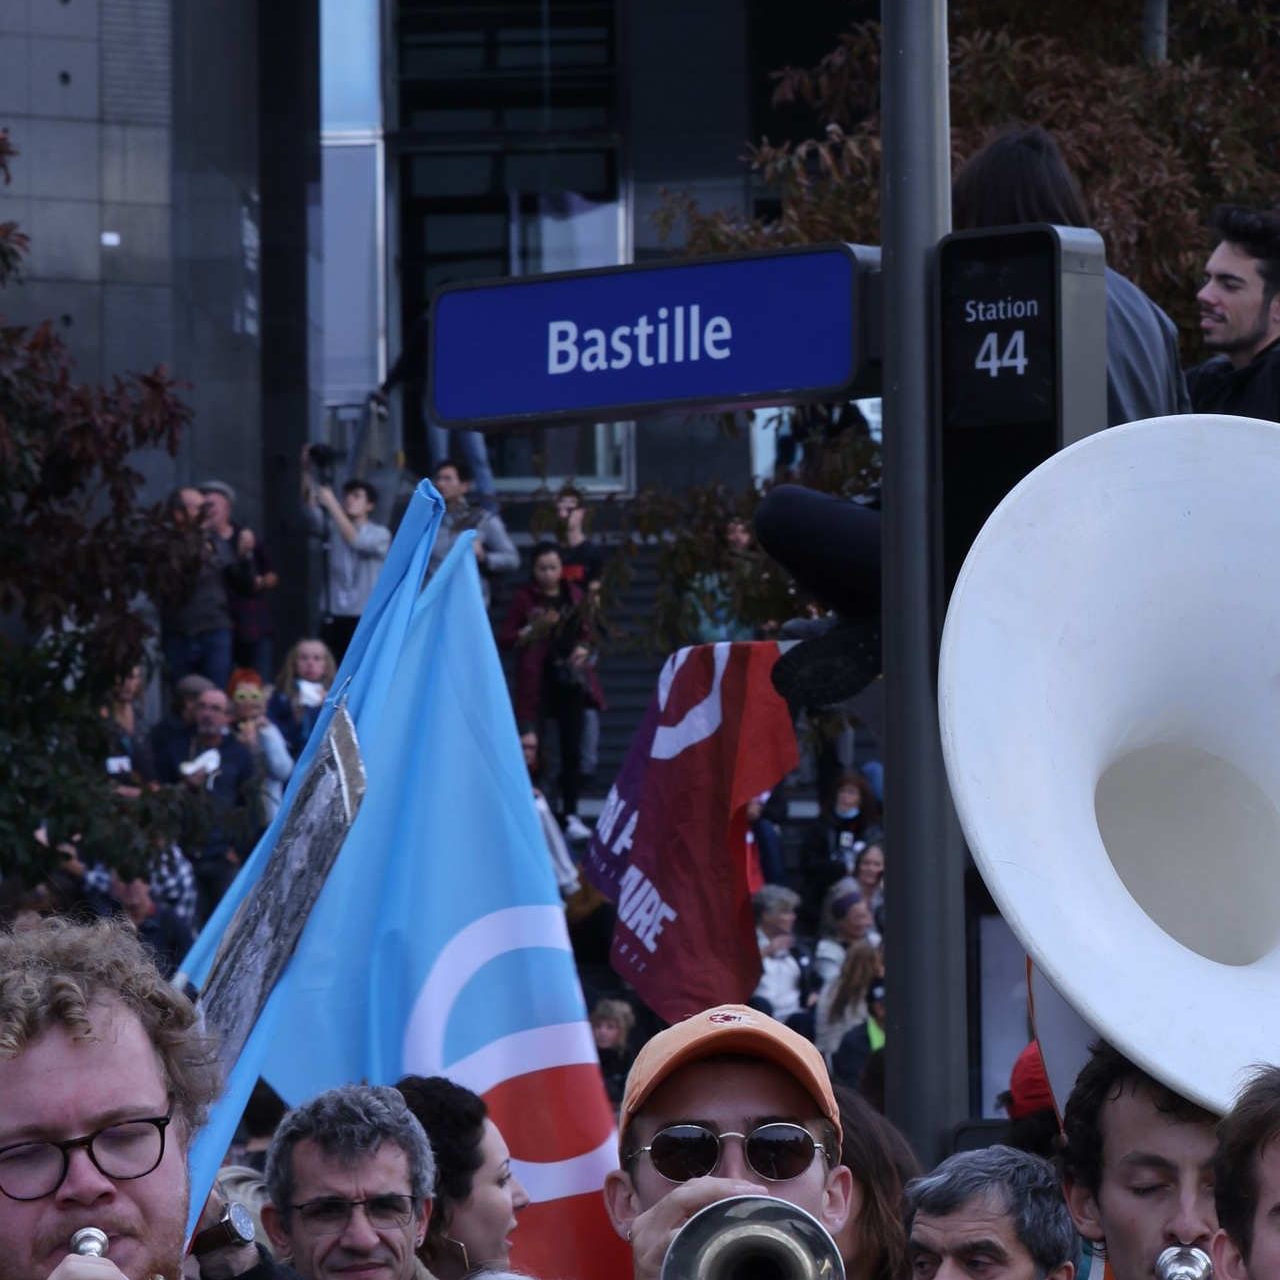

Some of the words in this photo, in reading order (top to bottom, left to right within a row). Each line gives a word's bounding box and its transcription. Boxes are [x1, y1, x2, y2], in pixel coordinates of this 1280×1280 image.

[964, 295, 1039, 324] Station
[546, 304, 733, 376] Bastille
[974, 329, 1029, 379] 44
